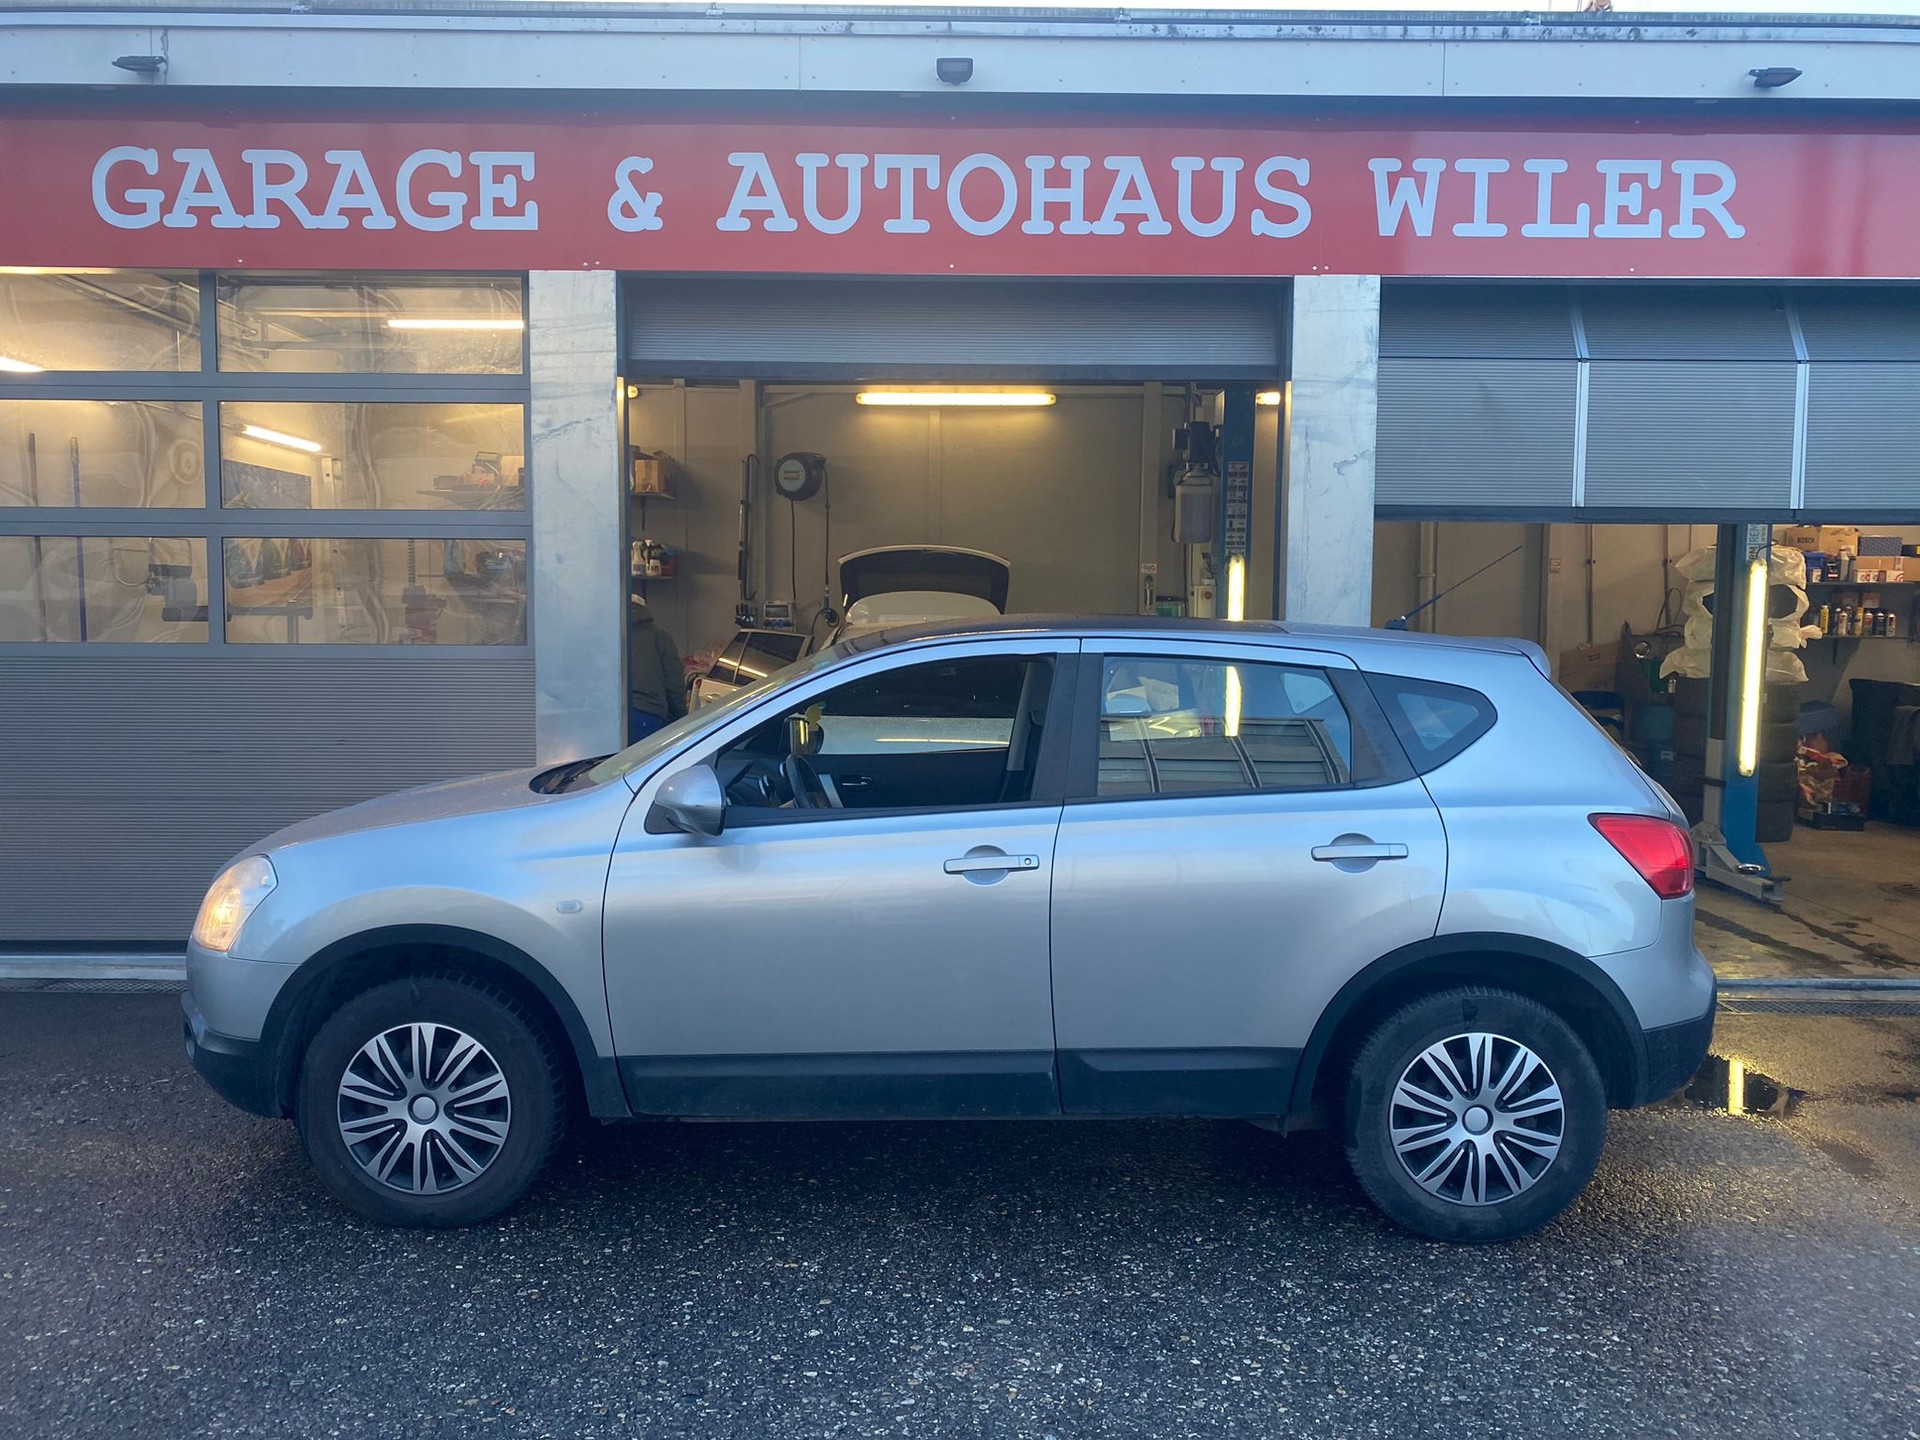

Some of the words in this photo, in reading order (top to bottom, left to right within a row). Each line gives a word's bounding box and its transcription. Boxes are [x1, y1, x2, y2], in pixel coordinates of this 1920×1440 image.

[92, 146, 539, 232] GARAGE
[608, 156, 664, 233] &
[716, 152, 1312, 238] AUTOHAUS
[1368, 158, 1746, 239] WILER
